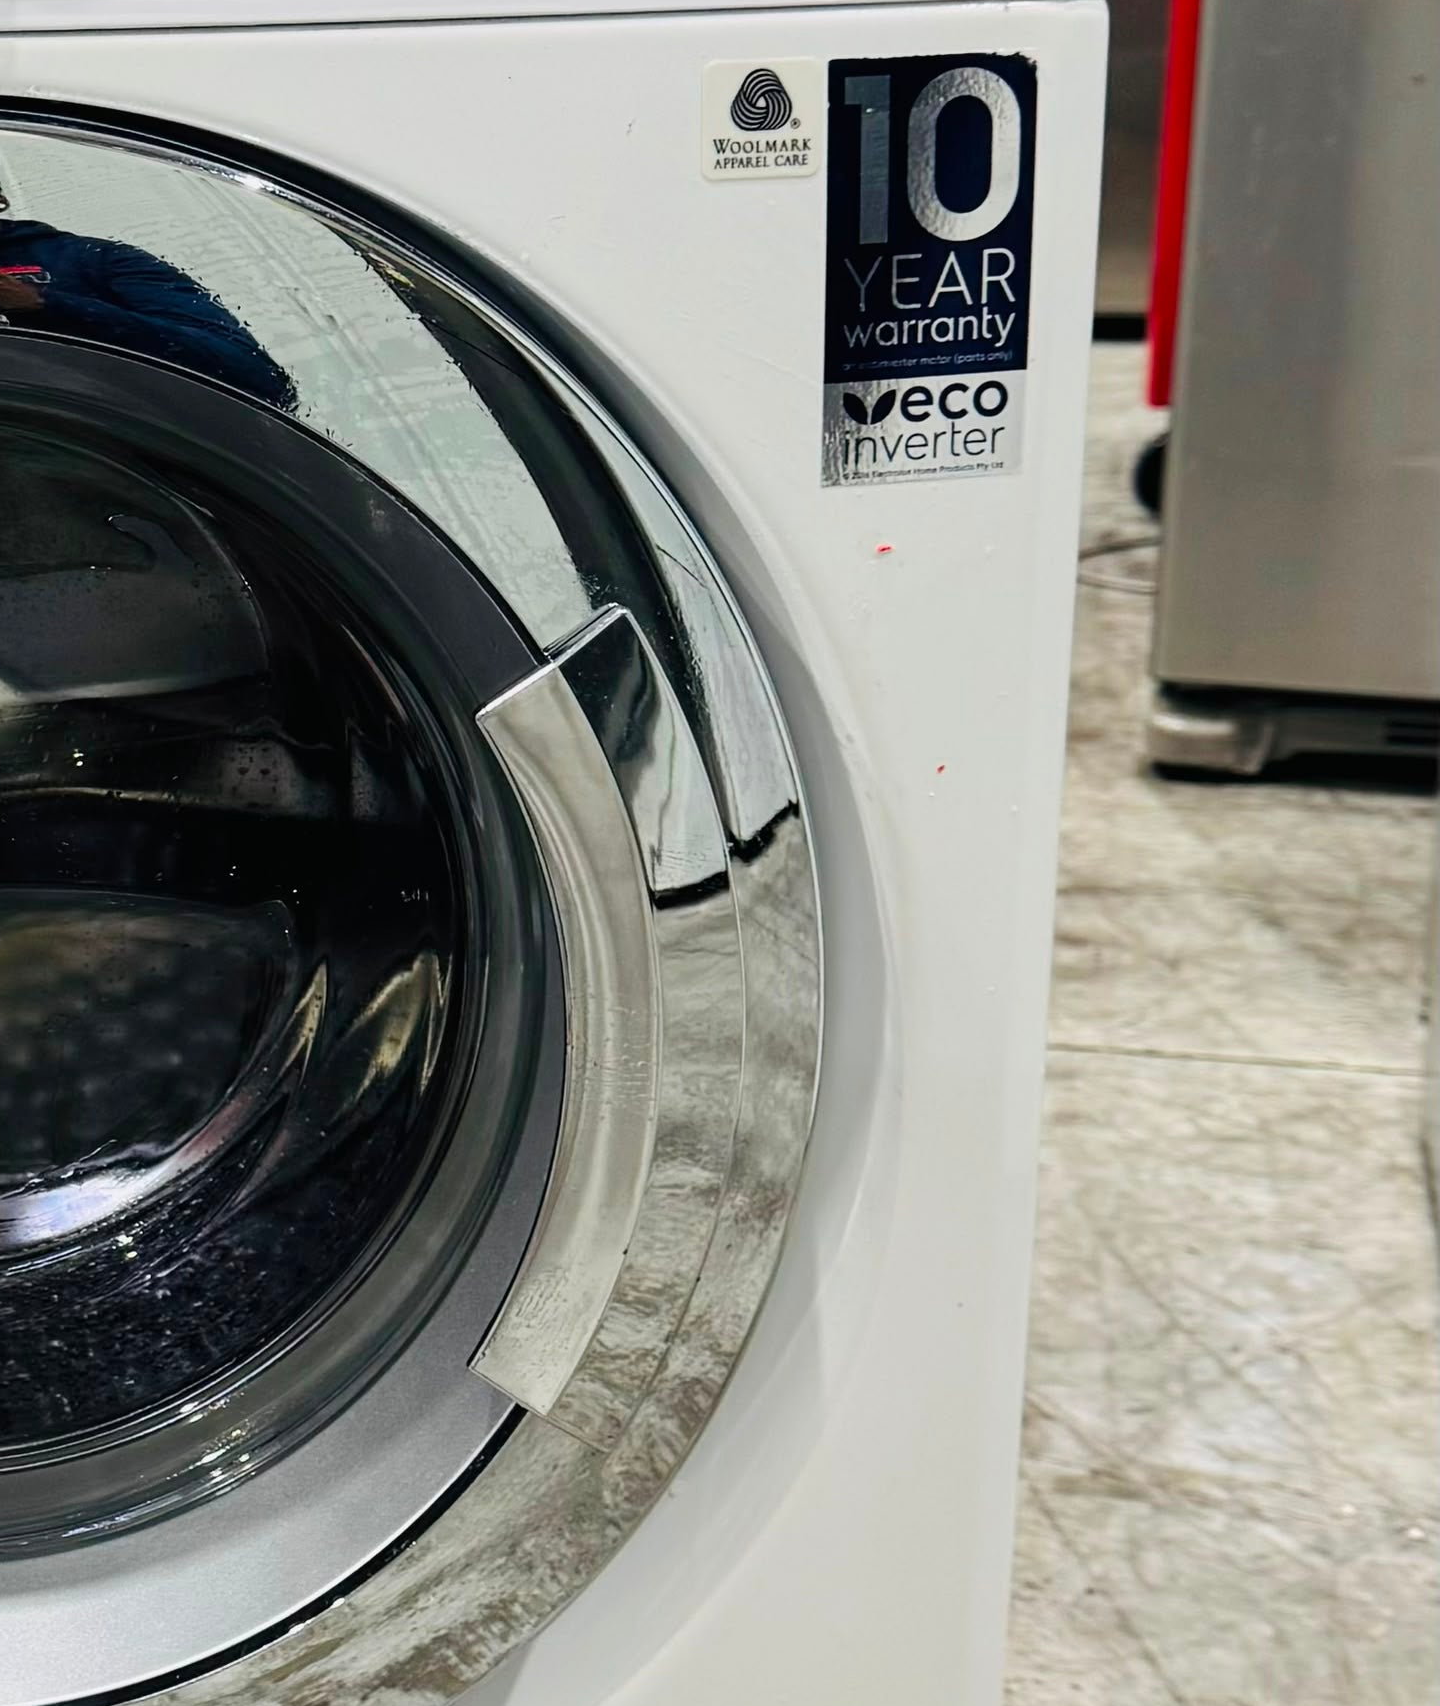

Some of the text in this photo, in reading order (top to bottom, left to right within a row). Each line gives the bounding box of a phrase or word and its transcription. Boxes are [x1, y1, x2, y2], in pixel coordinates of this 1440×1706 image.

[714, 153, 809, 170] APPAREL CARE
[844, 67, 1022, 245] 10
[844, 247, 1016, 312] YEAR
[843, 306, 1016, 348] warranty
[953, 351, 984, 365] (parts
[900, 380, 1008, 423] eco
[844, 421, 1006, 469] inverter
